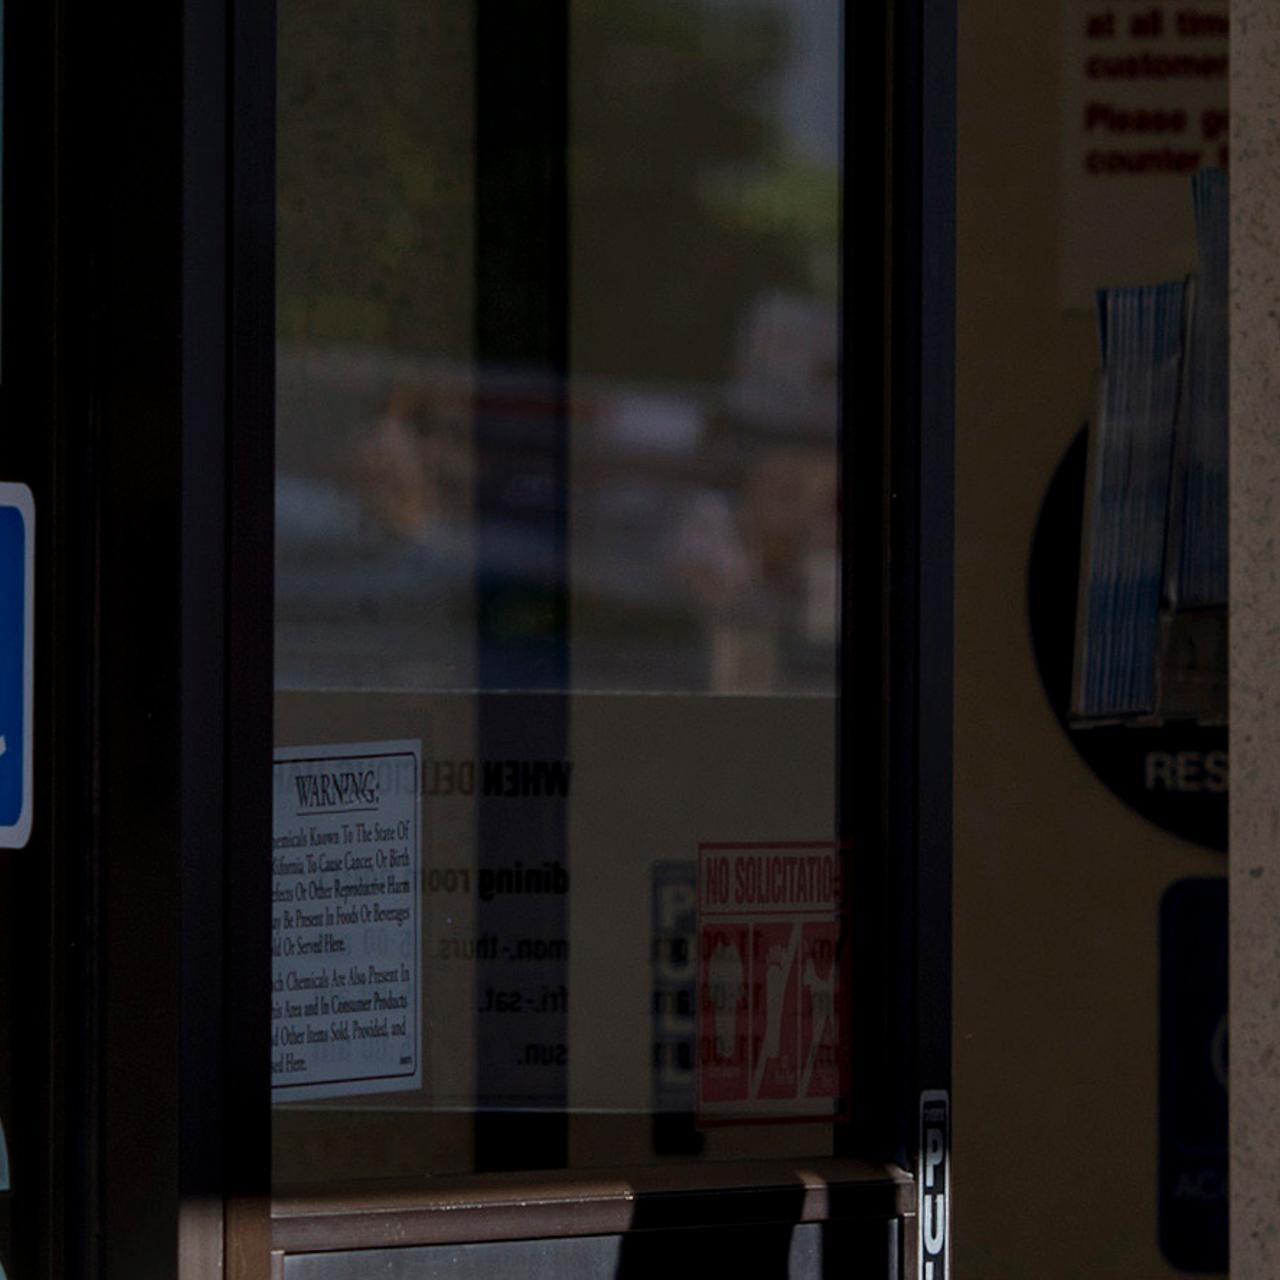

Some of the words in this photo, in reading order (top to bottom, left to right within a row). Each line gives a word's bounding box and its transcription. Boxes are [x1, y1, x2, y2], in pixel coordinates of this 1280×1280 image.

[1144, 750, 1229, 793] RES
[295, 770, 380, 807] WARNING:
[310, 826, 339, 847] Known
[341, 824, 353, 843] To
[356, 823, 372, 843] The
[374, 822, 395, 841] State
[397, 819, 409, 840] Of
[306, 854, 317, 873] To
[319, 853, 342, 872] Cause
[376, 849, 387, 869] Or
[389, 847, 409, 868] Birth
[295, 882, 306, 900] Or
[308, 880, 332, 900] Other
[335, 878, 385, 904] Reproductive
[387, 875, 409, 894] Harm
[706, 856, 730, 904] NO
[734, 855, 841, 905] SOLICITATIO
[284, 910, 294, 929] Be
[296, 908, 323, 928] Present
[326, 907, 334, 926] In
[336, 905, 359, 925] Foods
[360, 904, 371, 923] Or
[374, 903, 410, 928] Beverages
[284, 936, 295, 956] Or
[297, 934, 322, 955] Served
[286, 968, 329, 991] Chemicals
[331, 968, 346, 988] Are
[348, 965, 366, 986] Also
[368, 964, 398, 984] Present
[400, 962, 410, 982] In
[284, 999, 302, 1018] Area
[304, 996, 319, 1017] and
[321, 996, 329, 1015] In
[331, 994, 372, 1014] Consumer
[373, 990, 408, 1011] Products
[281, 1024, 305, 1046] Other
[306, 1023, 328, 1044] Items
[391, 1016, 406, 1036] and
